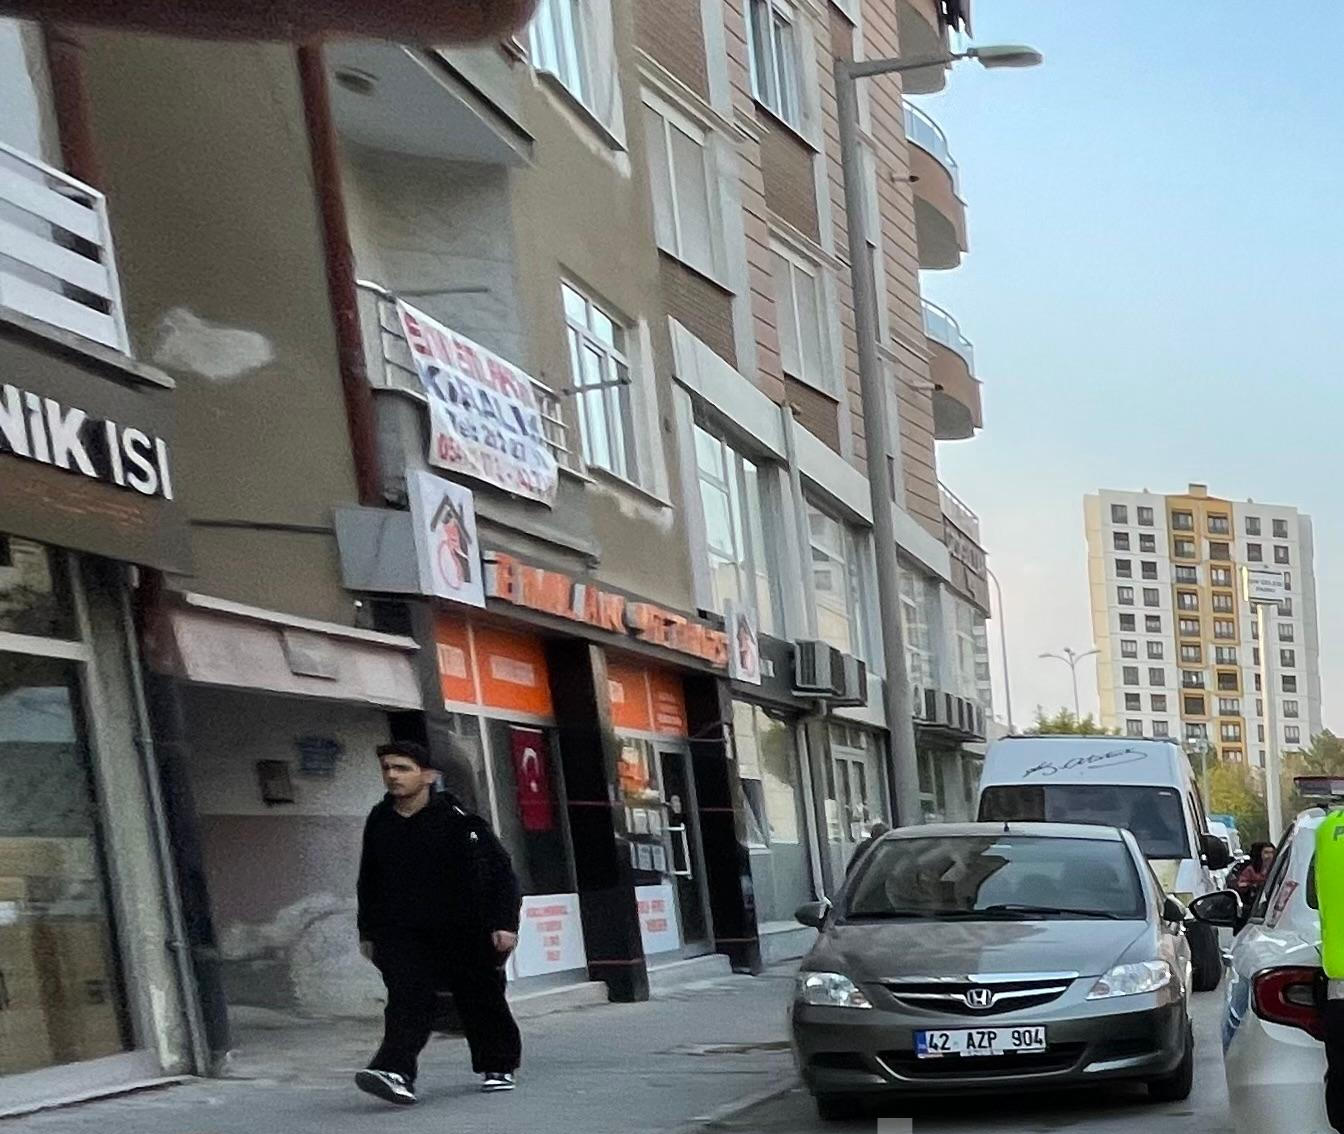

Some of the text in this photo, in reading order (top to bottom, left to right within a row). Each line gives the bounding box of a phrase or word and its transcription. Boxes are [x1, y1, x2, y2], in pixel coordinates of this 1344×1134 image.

[928, 1029, 1043, 1051] 42 AZP 904
